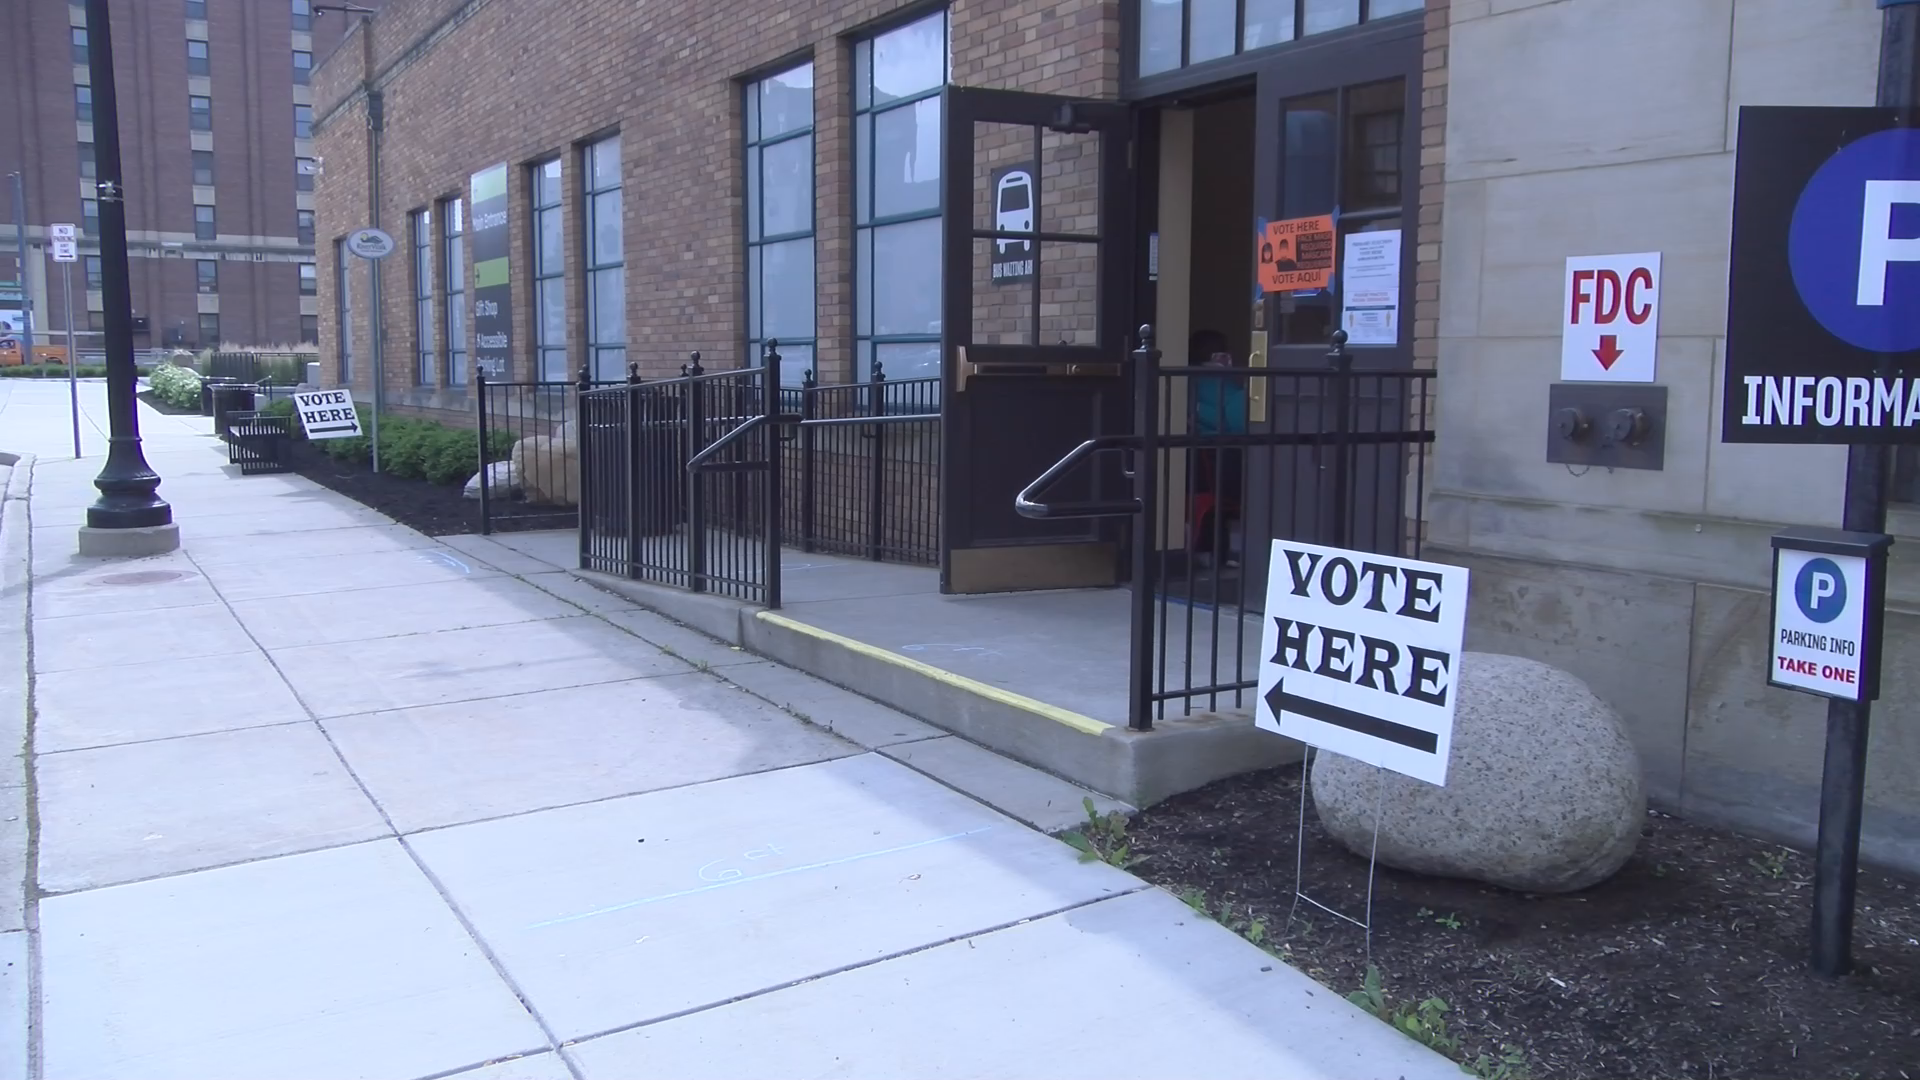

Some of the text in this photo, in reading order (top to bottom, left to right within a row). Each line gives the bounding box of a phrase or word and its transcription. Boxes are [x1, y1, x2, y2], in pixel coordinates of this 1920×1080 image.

[58, 227, 68, 235] NO
[1273, 220, 1319, 235] VOTE HERE
[1856, 179, 1920, 306] P
[1003, 260, 1024, 277] WAITING
[1272, 273, 1294, 285] VOTE
[1571, 267, 1653, 325] FDC
[298, 392, 346, 406] VOTE
[303, 408, 356, 423] HERE
[1283, 549, 1443, 623] VOTE
[1810, 571, 1836, 609] P
[1780, 628, 1855, 657] PARKING INFO
[1269, 616, 1451, 707] HERE
[1778, 656, 1856, 684] TAKE ONE
